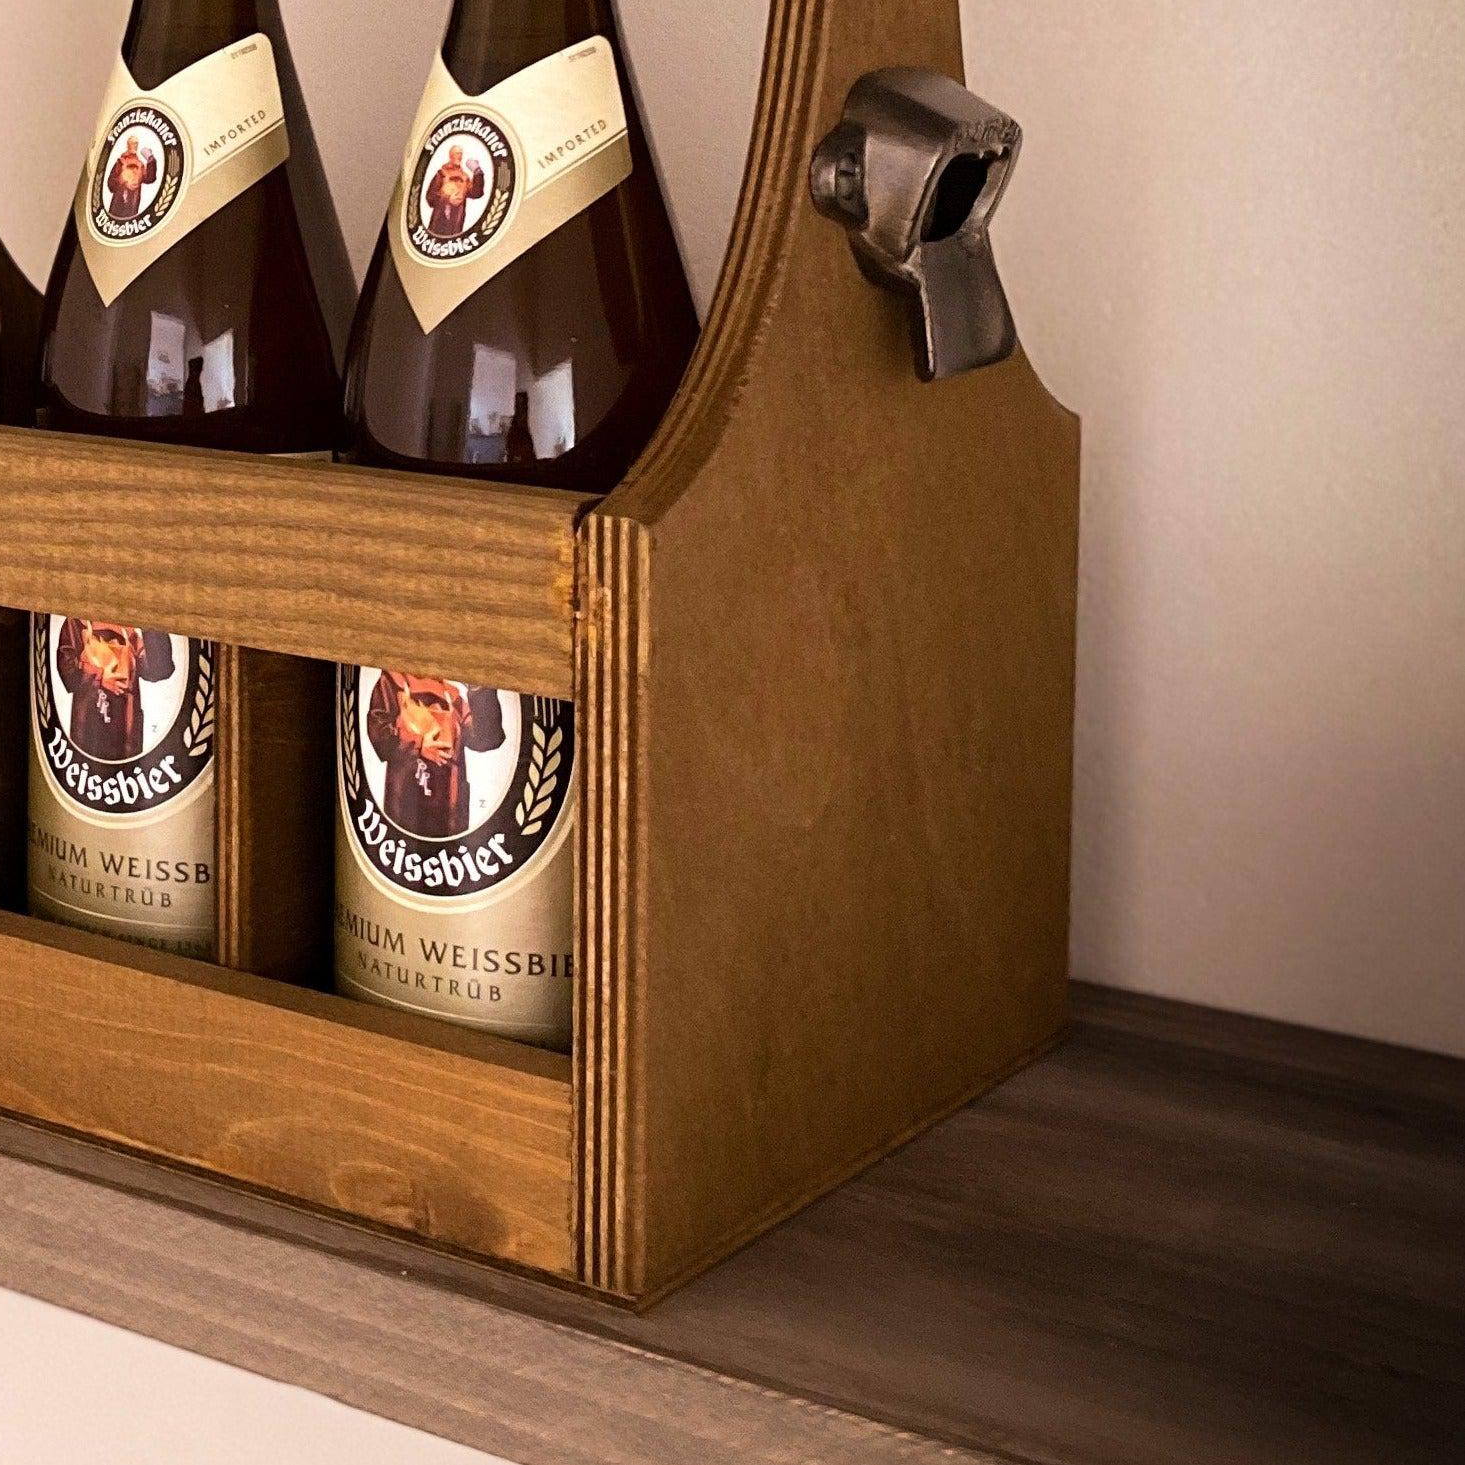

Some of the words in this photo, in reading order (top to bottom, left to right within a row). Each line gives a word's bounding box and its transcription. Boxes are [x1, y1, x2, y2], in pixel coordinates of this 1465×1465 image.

[107, 108, 178, 147] Franziskaner
[203, 109, 267, 156] IMPORTED
[424, 115, 509, 159] Franziskaner
[538, 119, 608, 169] IMPORTED
[95, 209, 153, 237] Weissbier
[412, 225, 479, 257] Weissbier
[47, 727, 183, 806] Weissbier
[357, 798, 514, 888] Weissbier
[99, 851, 210, 884] WEISSB
[358, 950, 501, 1002] NATURTRÜB
[419, 938, 574, 978] WEISSBIE
